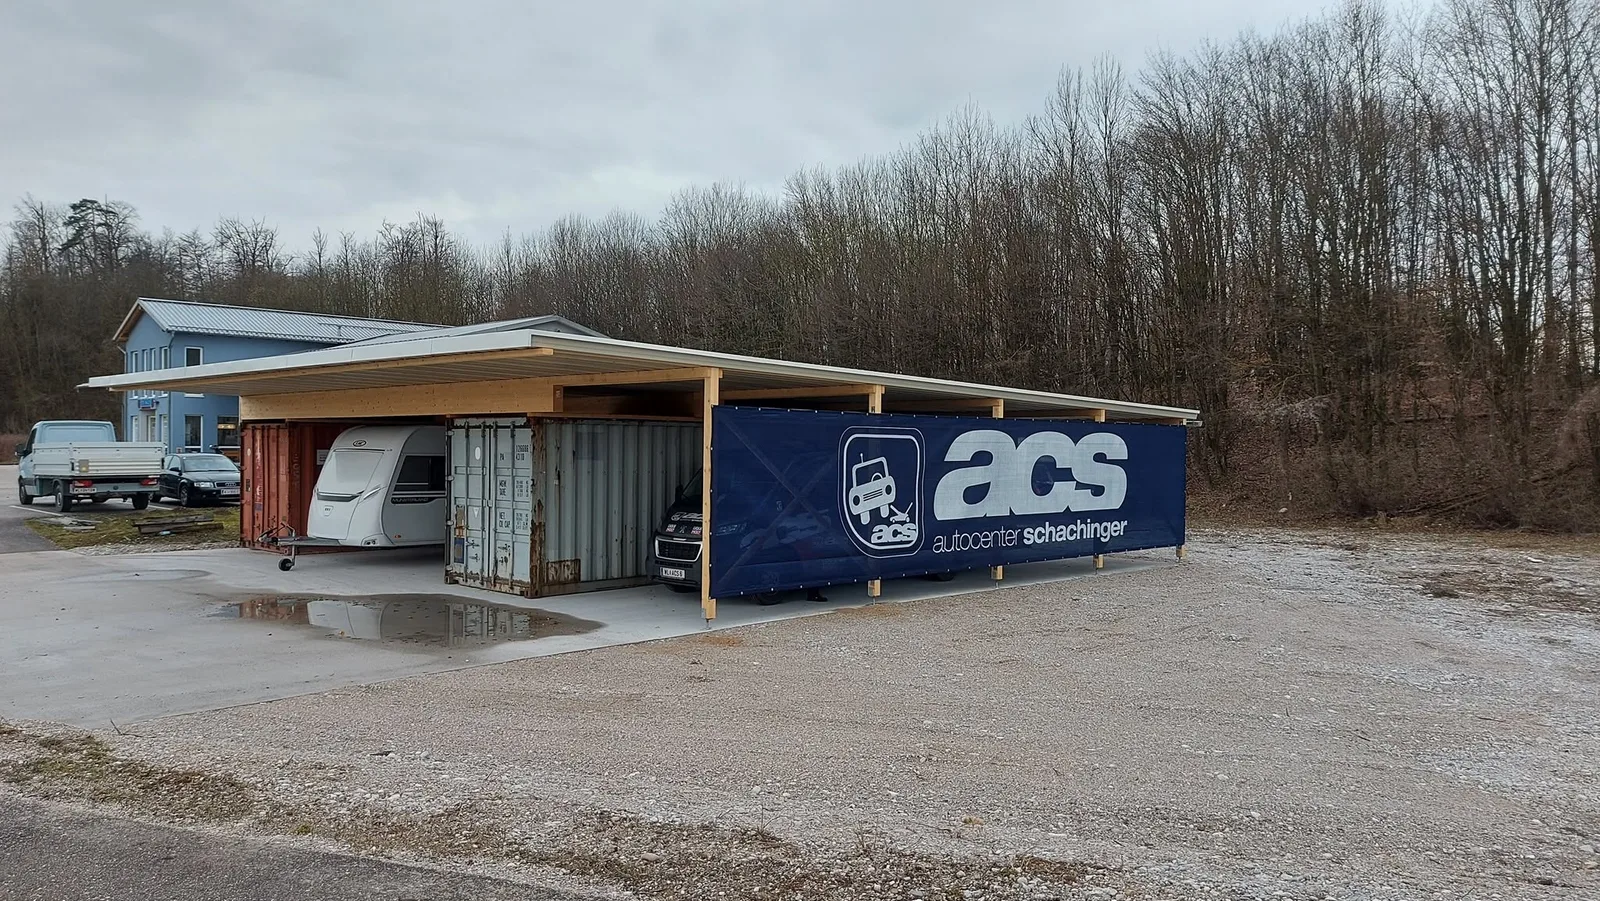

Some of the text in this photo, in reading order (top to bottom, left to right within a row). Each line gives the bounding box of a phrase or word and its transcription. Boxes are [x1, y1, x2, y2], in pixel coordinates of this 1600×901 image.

[933, 429, 1128, 521] acs
[871, 523, 917, 543] acs
[932, 518, 1128, 554] autocenter schachinger
